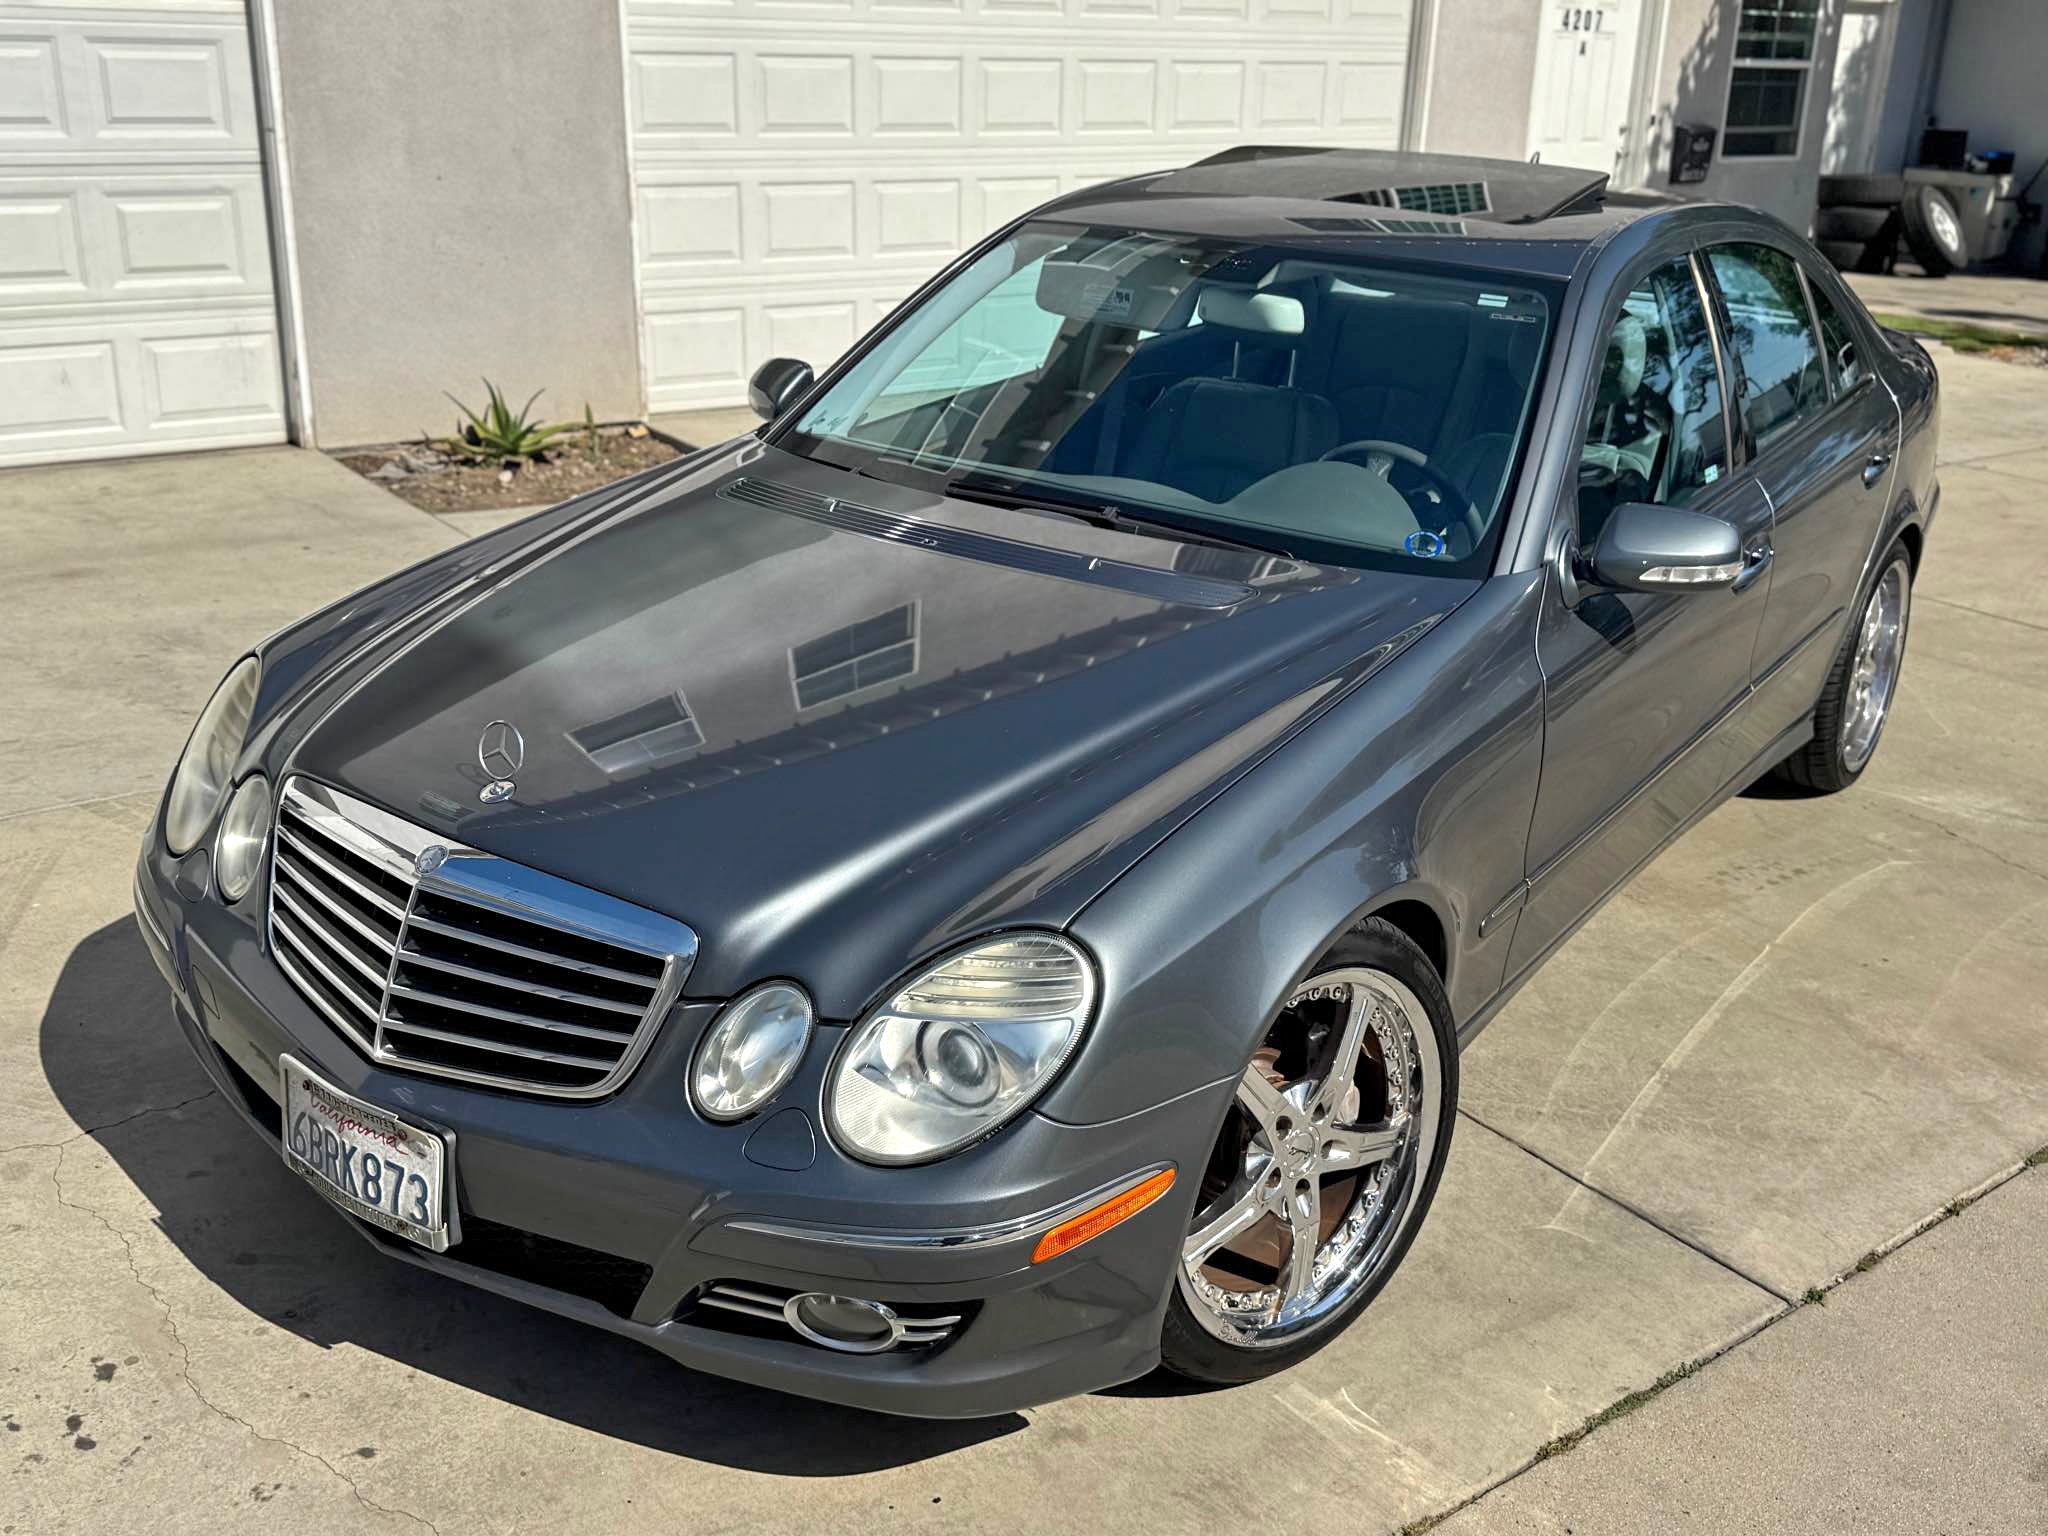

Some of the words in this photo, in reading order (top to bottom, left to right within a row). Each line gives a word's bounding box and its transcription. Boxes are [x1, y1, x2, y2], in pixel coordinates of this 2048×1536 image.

[1562, 8, 1603, 32] 4207
[310, 1093, 408, 1155] California
[293, 1111, 430, 1227] 6BRK873
